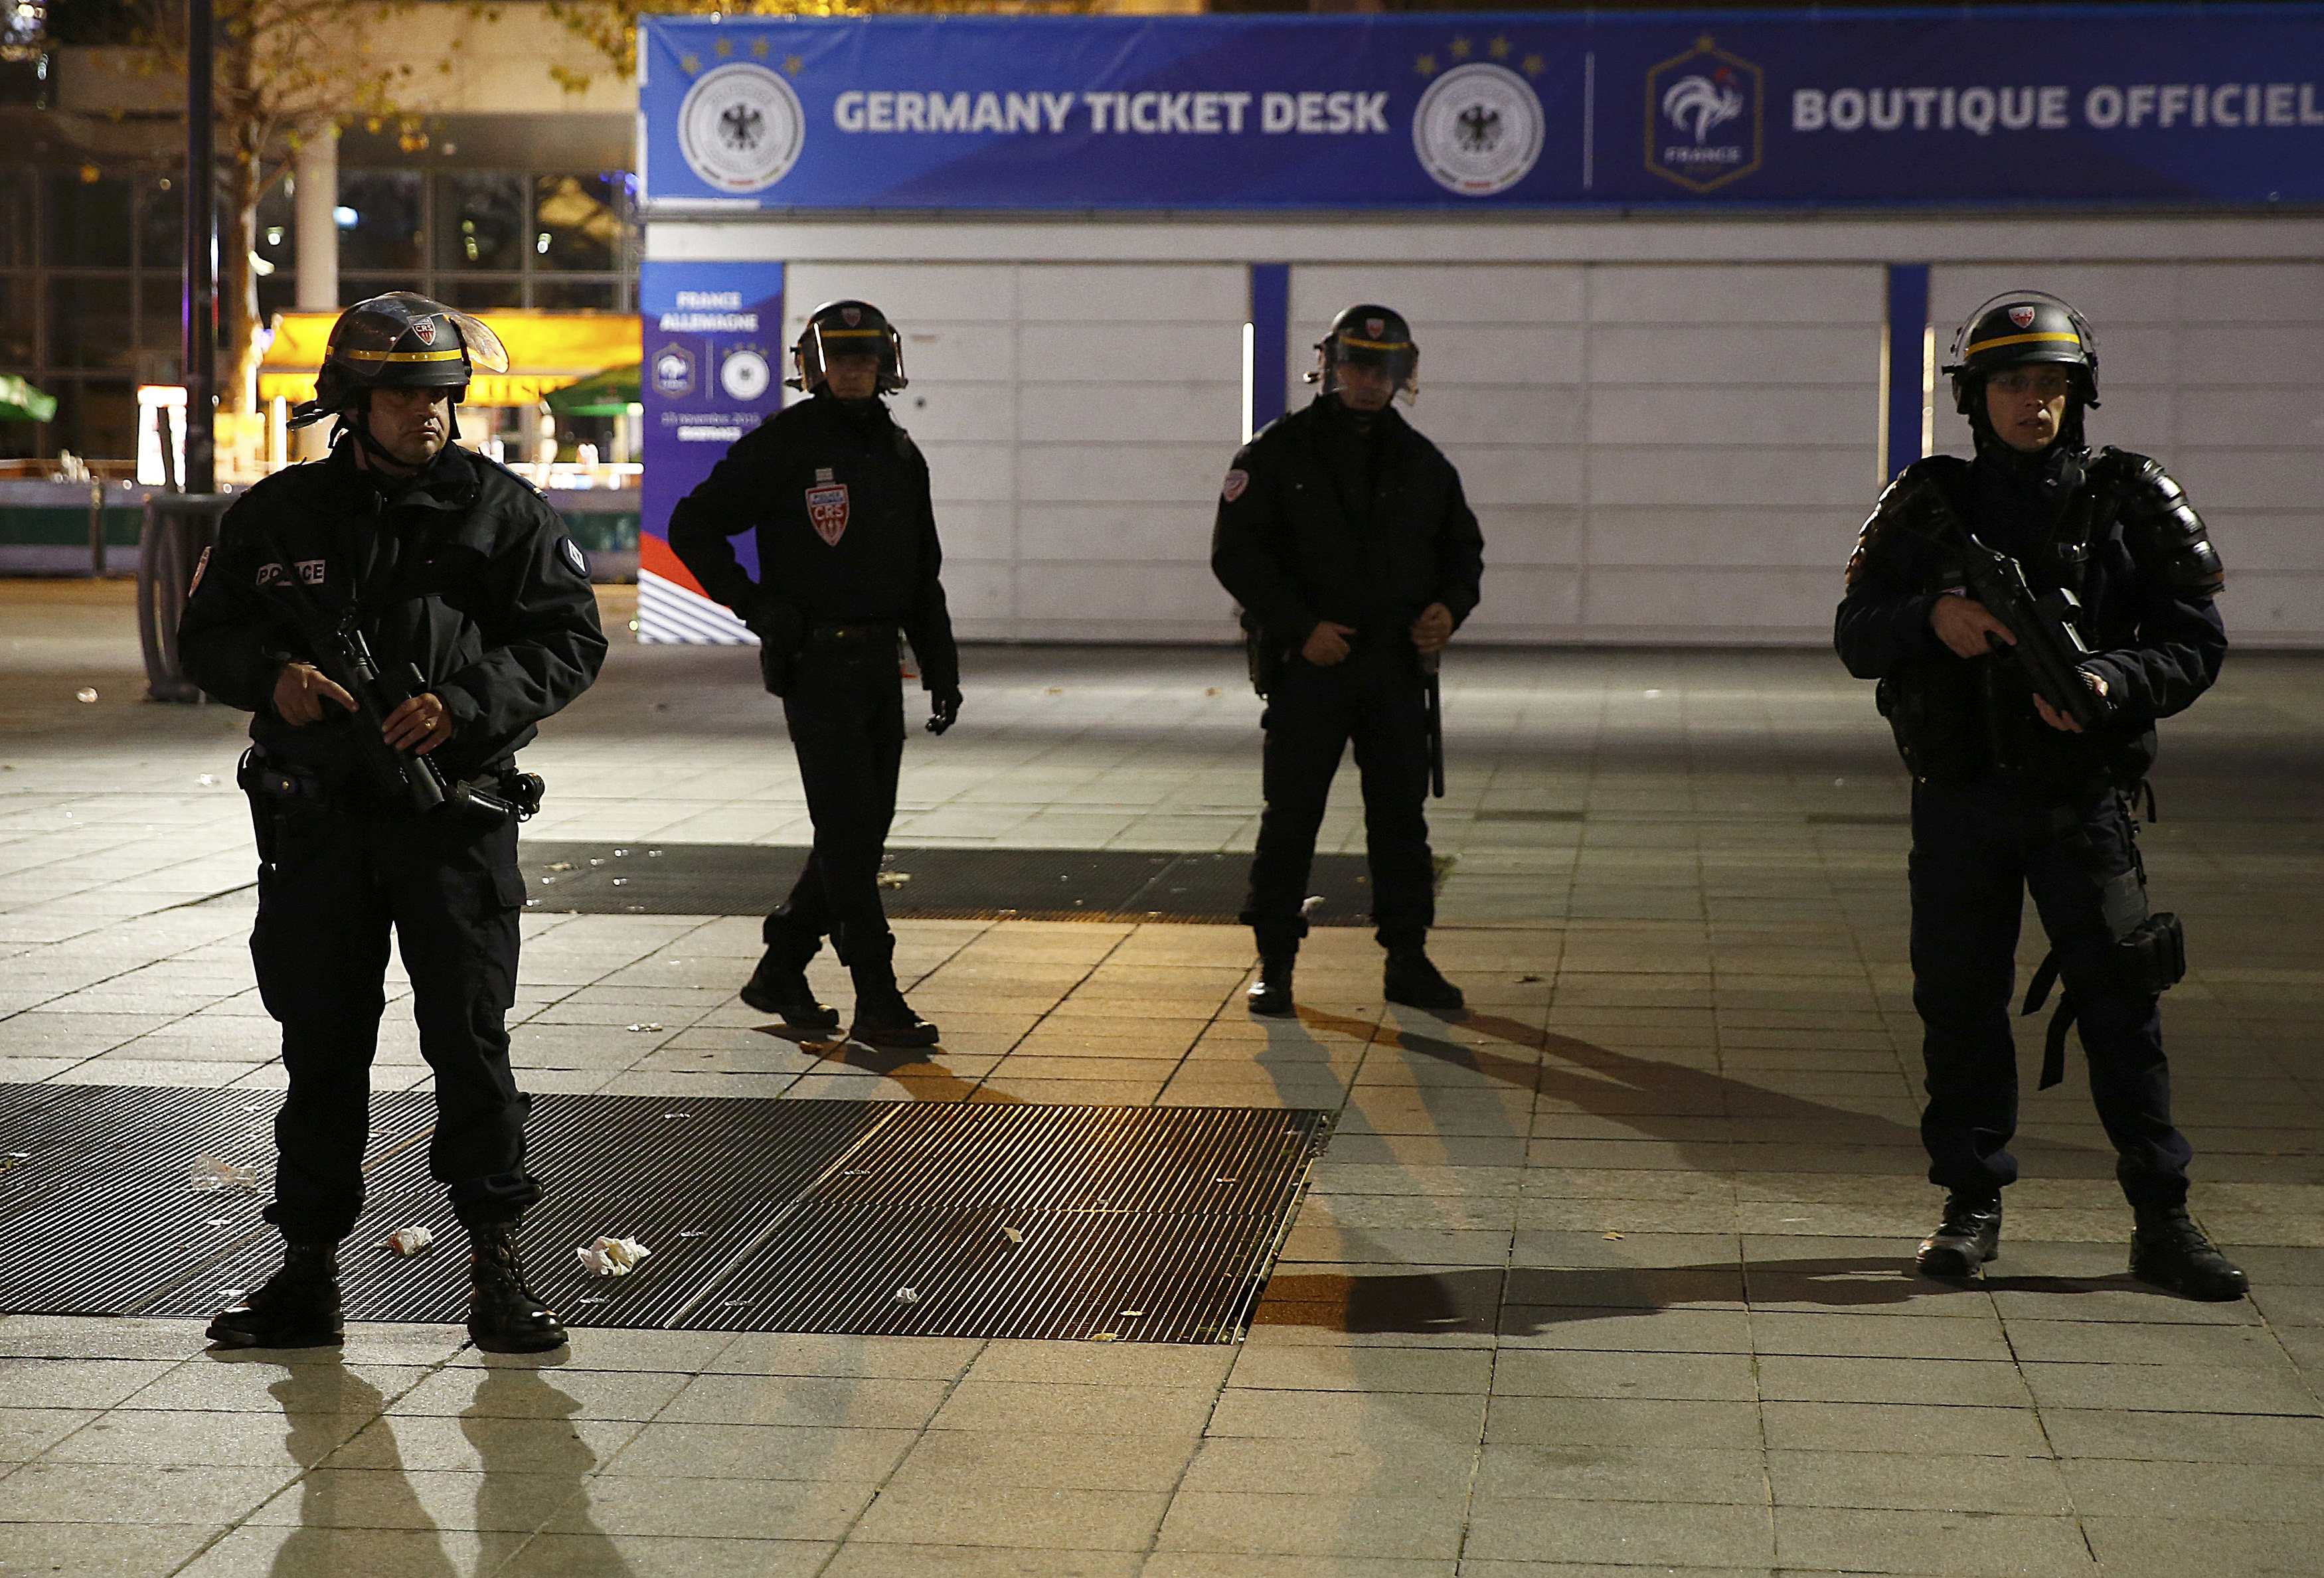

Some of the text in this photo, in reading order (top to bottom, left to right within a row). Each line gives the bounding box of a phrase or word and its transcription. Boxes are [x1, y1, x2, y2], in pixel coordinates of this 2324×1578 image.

[834, 91, 1074, 133] GERMANY
[1082, 92, 1252, 133] TICKET
[1262, 92, 1388, 133] DESK
[1793, 84, 2324, 135] BOUTIQUE OFFICIEL
[1664, 146, 1741, 163] FRANCE
[676, 291, 742, 310] FRANCE
[659, 313, 758, 332] ALLEMAGNE
[814, 506, 844, 520] CRS
